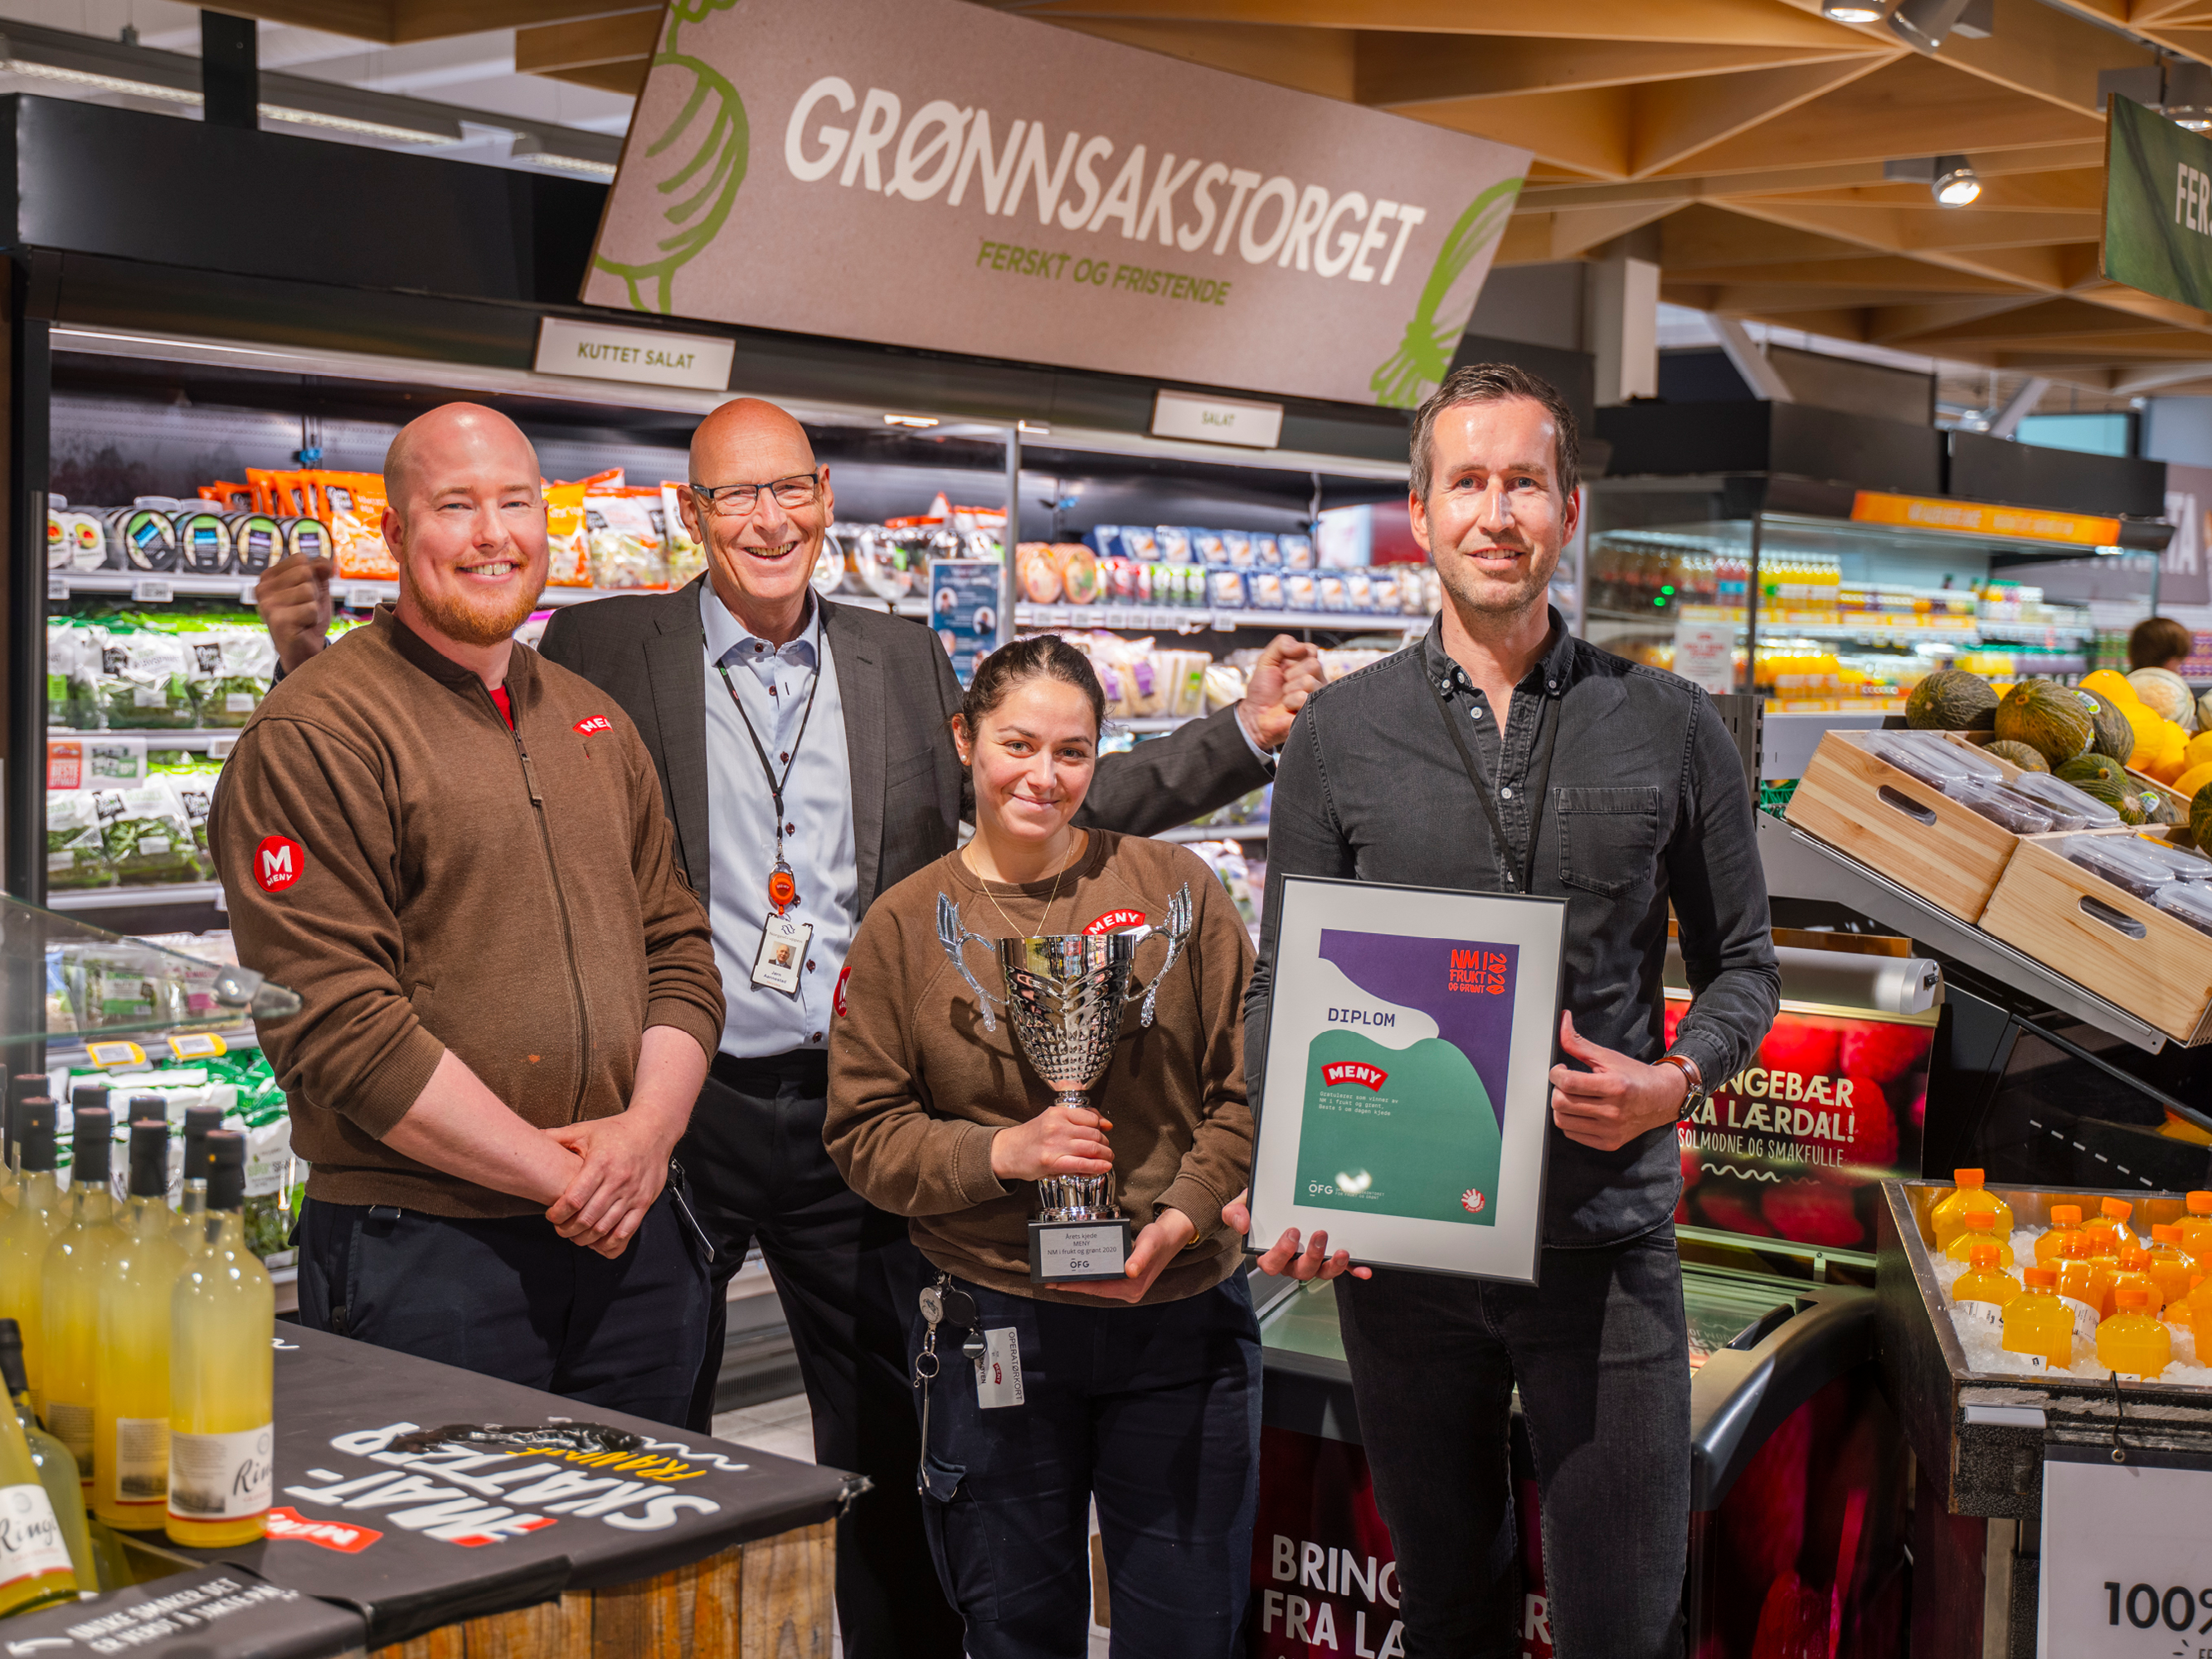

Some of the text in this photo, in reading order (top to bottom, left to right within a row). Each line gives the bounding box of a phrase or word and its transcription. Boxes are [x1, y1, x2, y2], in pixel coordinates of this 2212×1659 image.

[785, 75, 1427, 285] GRØNNSAKSTORGET
[2175, 162, 2212, 236] FER
[976, 241, 1232, 306] FERSKT OG FRISTENDE
[577, 342, 695, 369] KUTTET SALAT
[1201, 411, 1235, 426] SALAT
[262, 845, 293, 878] M
[266, 873, 293, 887] MENY
[1088, 912, 1139, 935] MENY
[769, 932, 803, 944] NorgesGruppen
[1451, 949, 1488, 971] NM I
[1450, 969, 1486, 984] FRUKT
[1486, 953, 1507, 995] 2020
[1448, 982, 1485, 994] OG GRØNT
[1328, 1007, 1395, 1027] DIPLOM
[1328, 1065, 1382, 1084] MENY
[1714, 1068, 1854, 1107] NGEBÆR
[1320, 1091, 1353, 1100] Gratulerer
[1728, 1099, 1855, 1143] LÆRDAL!
[1678, 1127, 1844, 1168] SOLMODNE OG SMAKFULLE
[1086, 1248, 1101, 1256] grønt
[1009, 1331, 1023, 1400] OPERATØRKORT
[126, 1588, 211, 1621] SMAKER
[197, 1577, 243, 1598] DET
[1262, 1589, 1338, 1651] FRA
